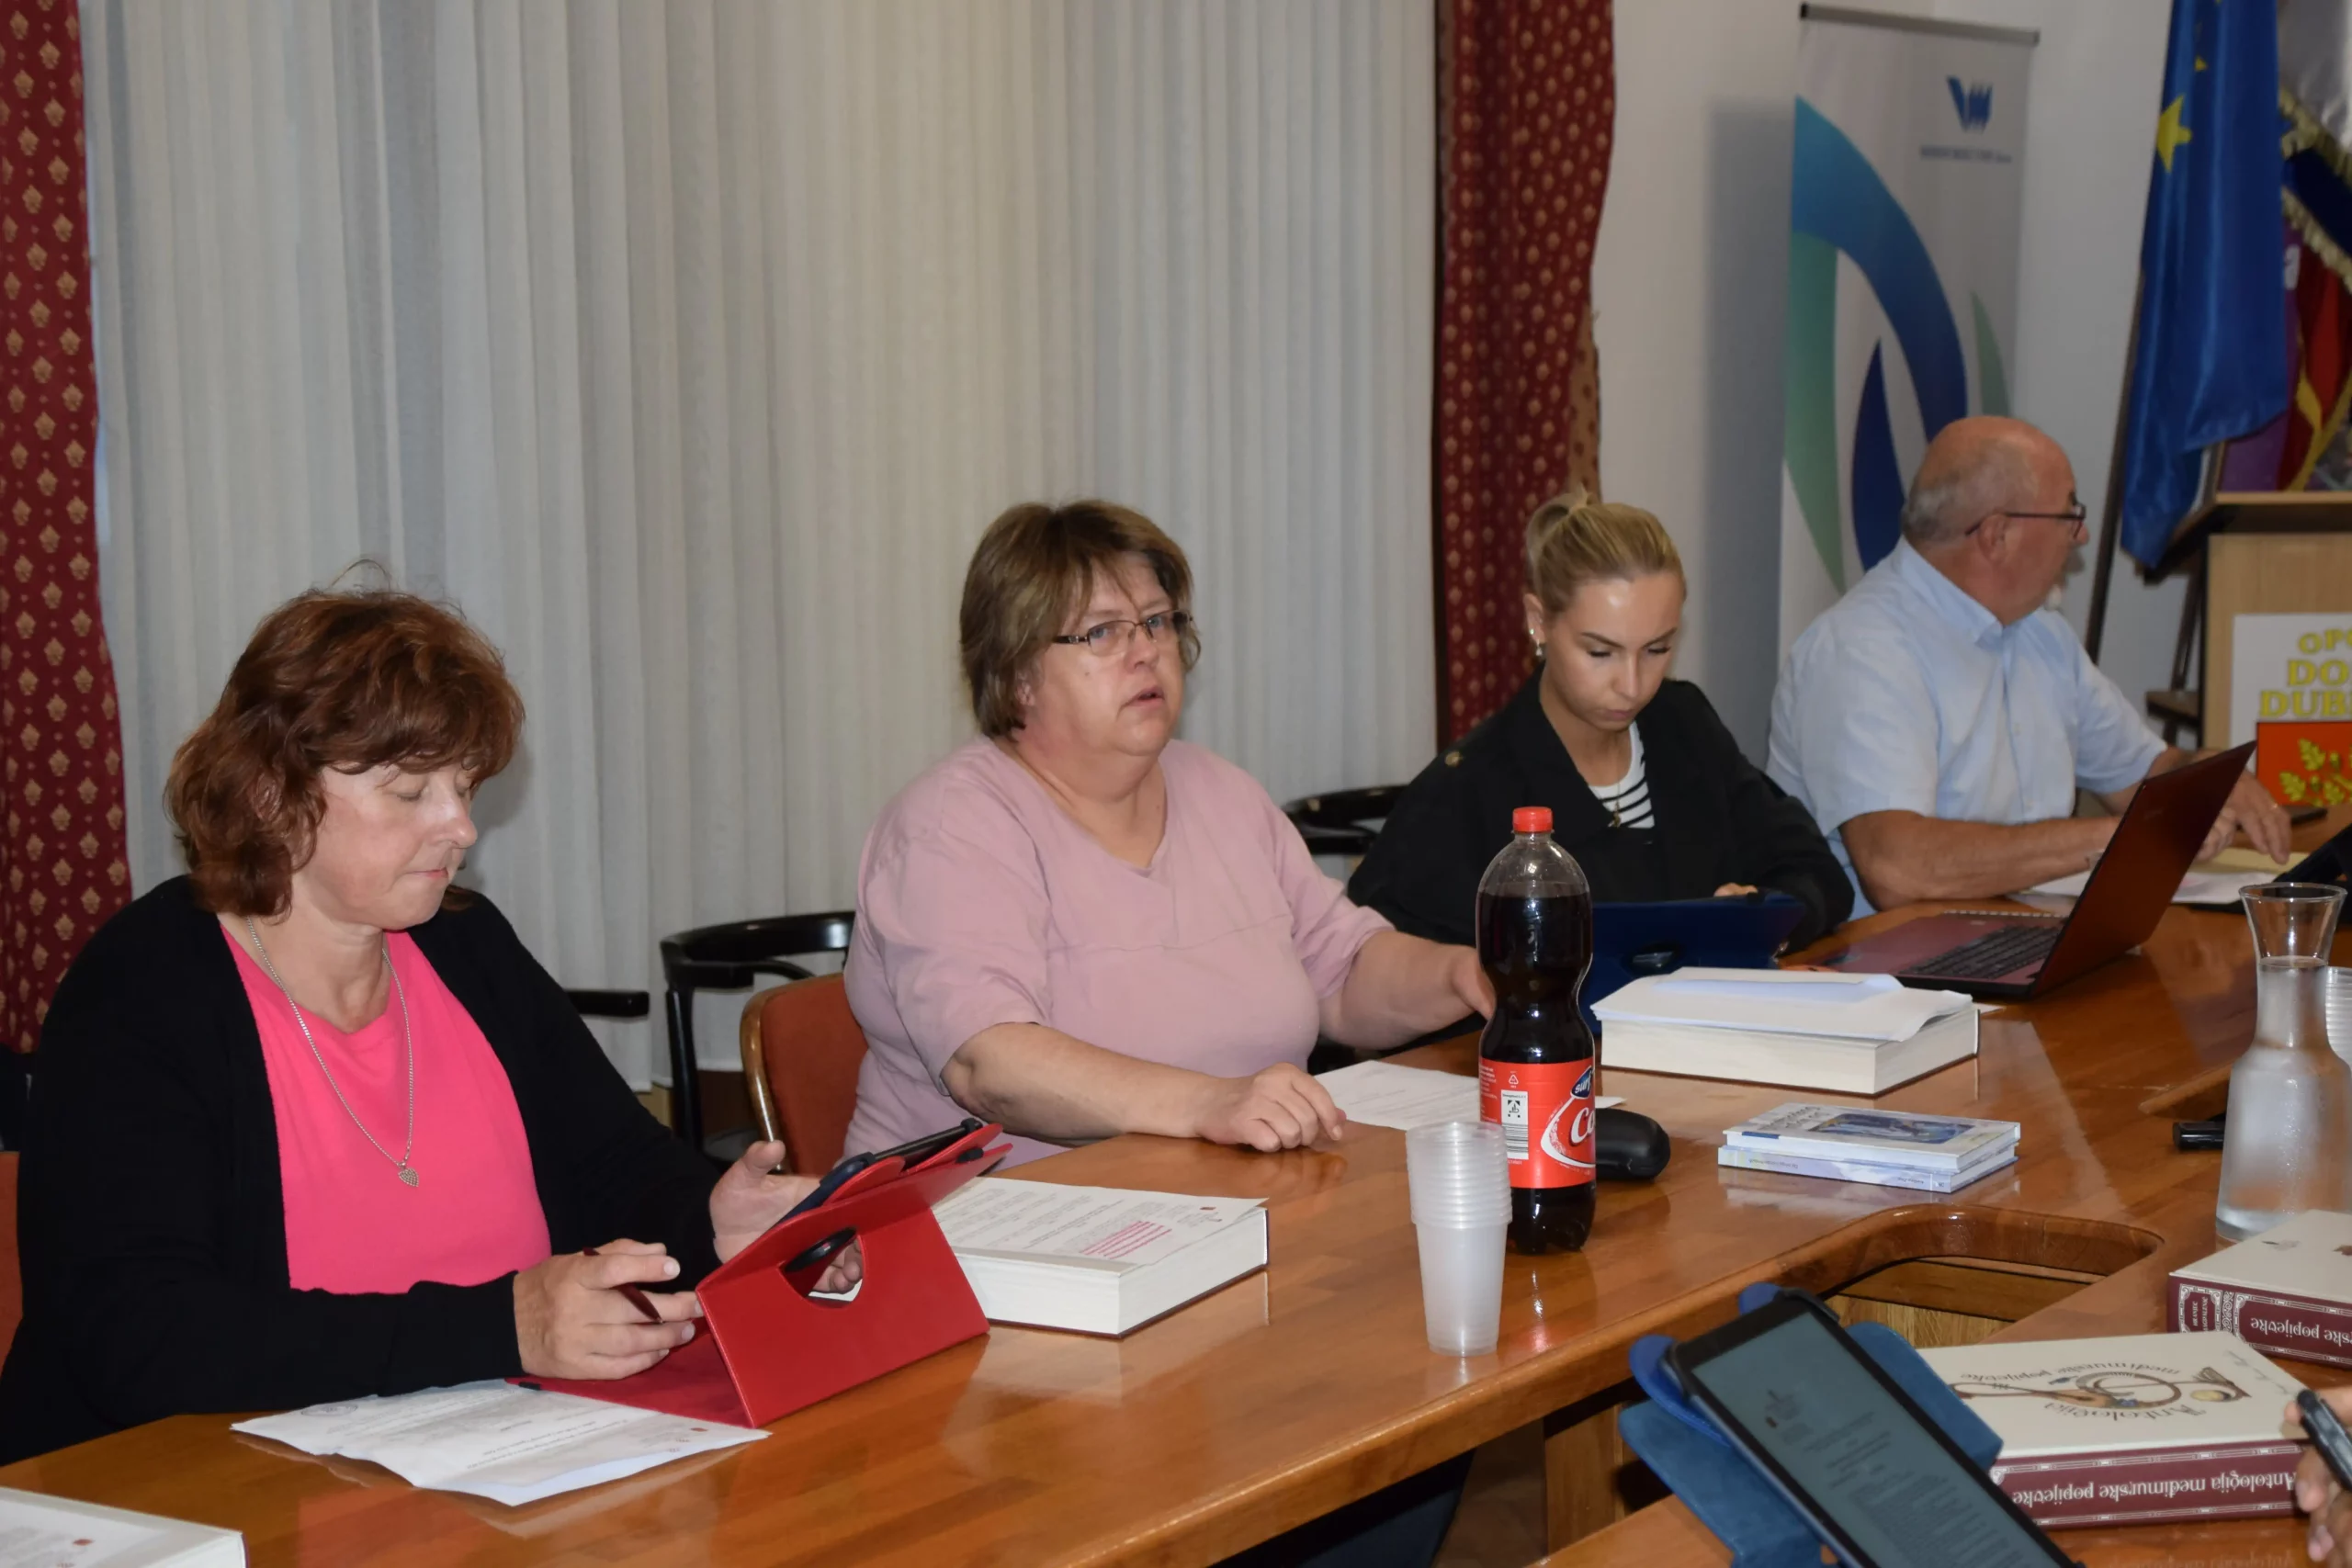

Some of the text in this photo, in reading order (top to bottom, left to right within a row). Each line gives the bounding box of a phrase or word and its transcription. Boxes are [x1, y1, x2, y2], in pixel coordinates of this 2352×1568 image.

[2260, 689, 2352, 717] DUB
[2250, 1317, 2320, 1339] popijevke
[2044, 1402, 2206, 1421] Antologija
[2012, 1470, 2297, 1507] Antologija međimurske popijevke
